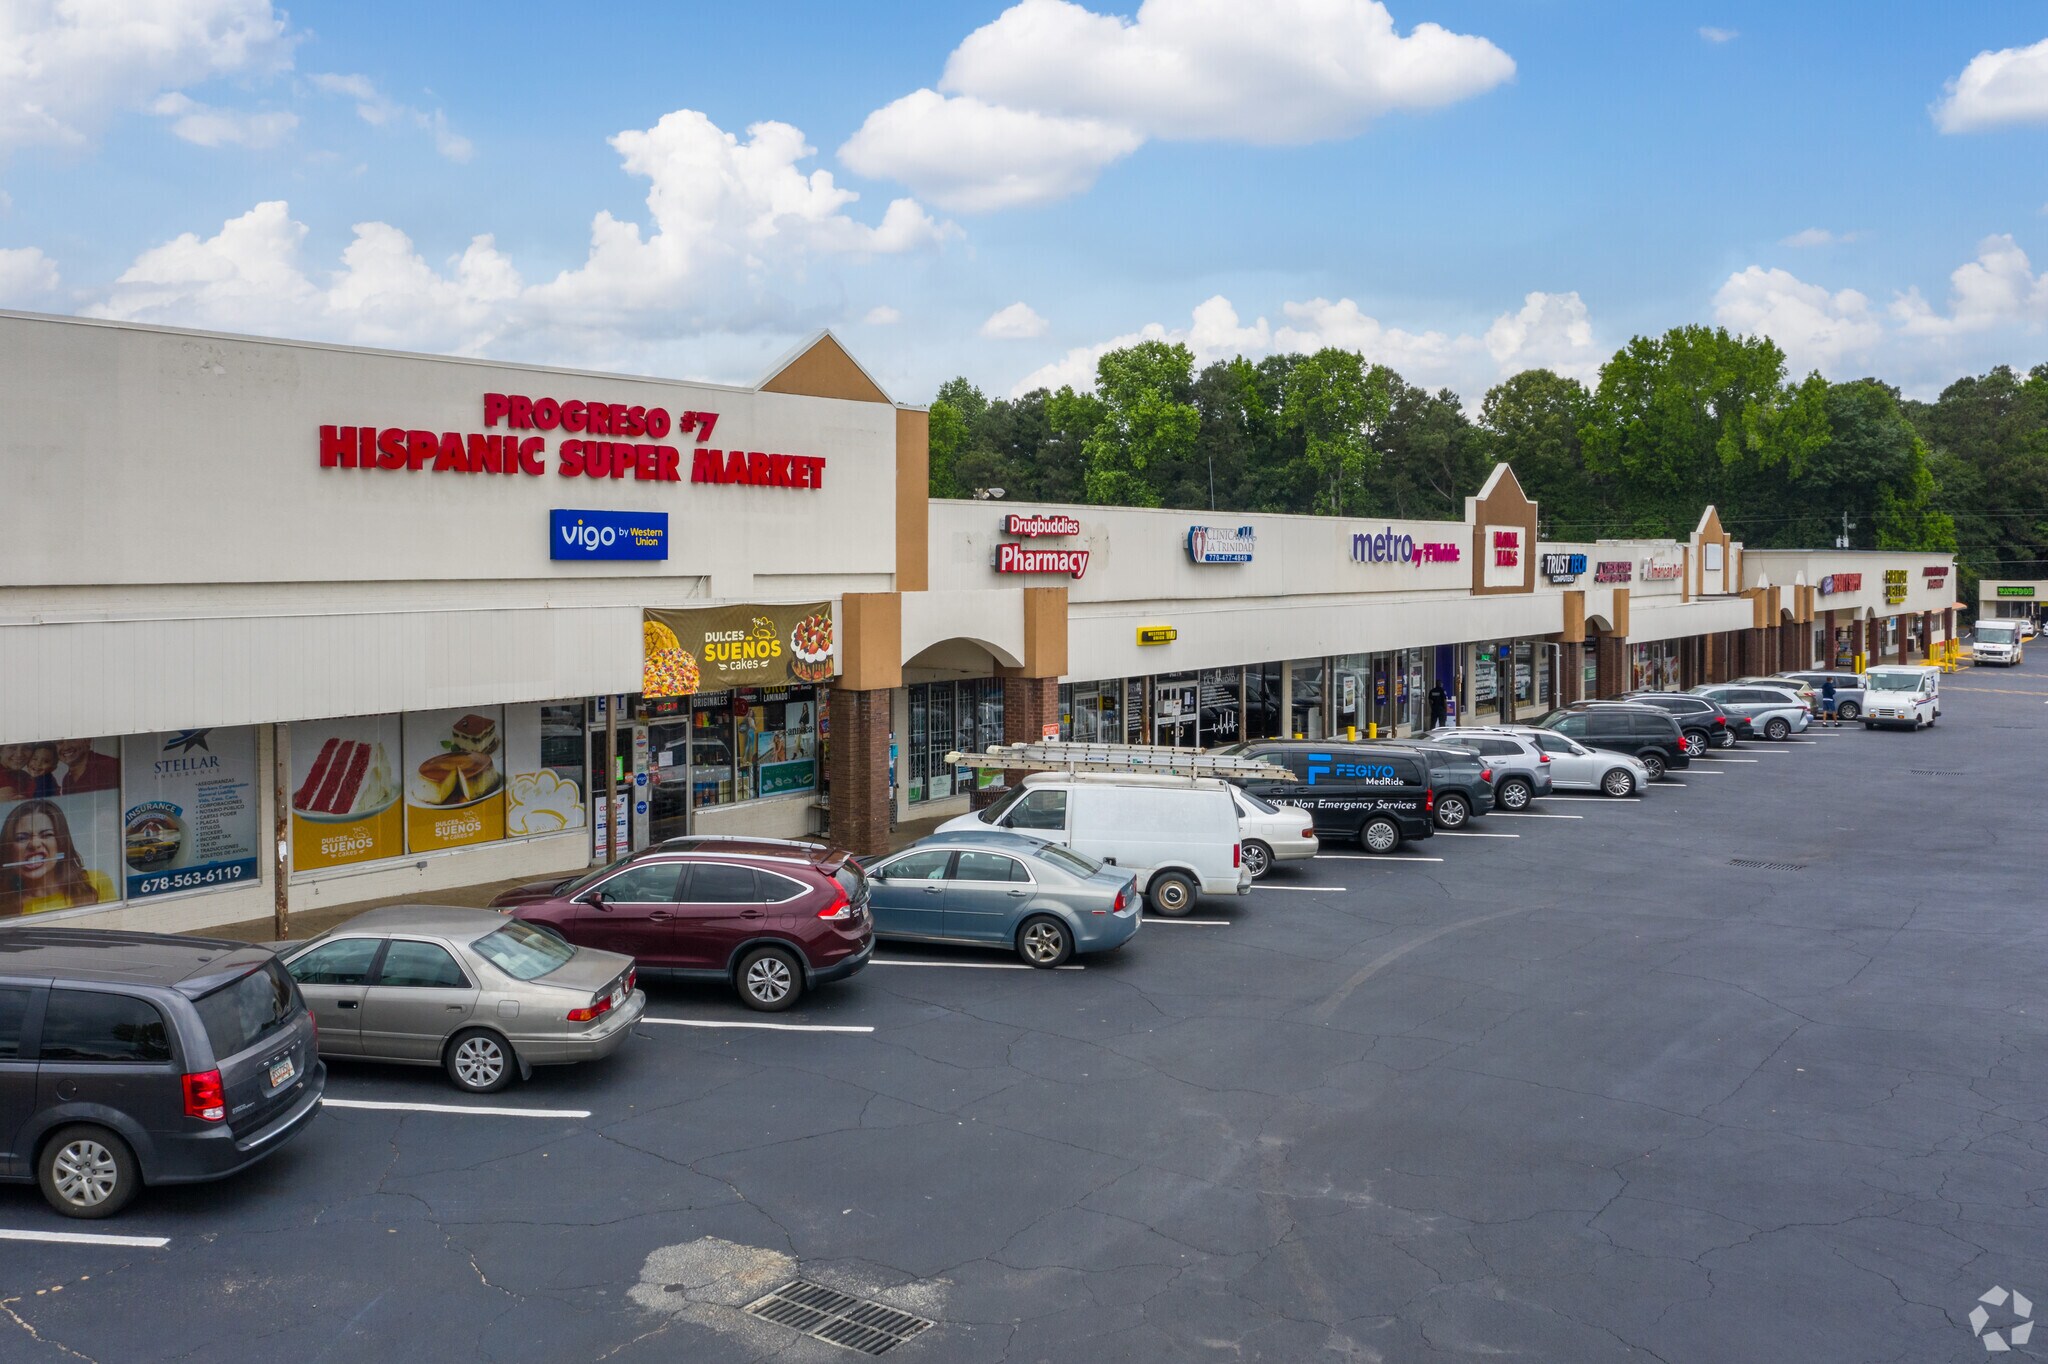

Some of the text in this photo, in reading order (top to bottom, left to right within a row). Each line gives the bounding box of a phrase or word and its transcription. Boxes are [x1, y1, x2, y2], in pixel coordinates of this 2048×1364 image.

[484, 393, 720, 442] PROGRESO #7
[319, 424, 826, 489] HISPANIC SUPER MARKET
[1010, 515, 1079, 537] Drugbuddies
[561, 519, 663, 551] vigo by Western
[635, 537, 659, 546] Union
[1353, 527, 1413, 562] metro
[1001, 545, 1089, 578] Pharmacy
[1547, 555, 1570, 574] TRUST
[1998, 587, 2034, 595] TATTOOS
[705, 630, 745, 642] DULCES
[704, 636, 782, 662] SUEÑOS
[730, 658, 759, 670] cakes
[693, 695, 728, 708] ORIGINALES
[154, 755, 220, 774] STELLAR
[1336, 764, 1395, 778] FEGIYO
[154, 768, 221, 780] INSURANCE
[1365, 777, 1404, 786] MedRide
[199, 807, 223, 815] NOTARIO
[1293, 799, 1315, 809] Non
[1318, 799, 1374, 811] Emergency
[1377, 799, 1417, 810] Services
[126, 803, 177, 821] INSURANCE
[435, 819, 459, 827] DULCES
[321, 835, 348, 844] DULCES
[338, 850, 357, 858] cakes
[141, 865, 242, 893] 678-563-6119
